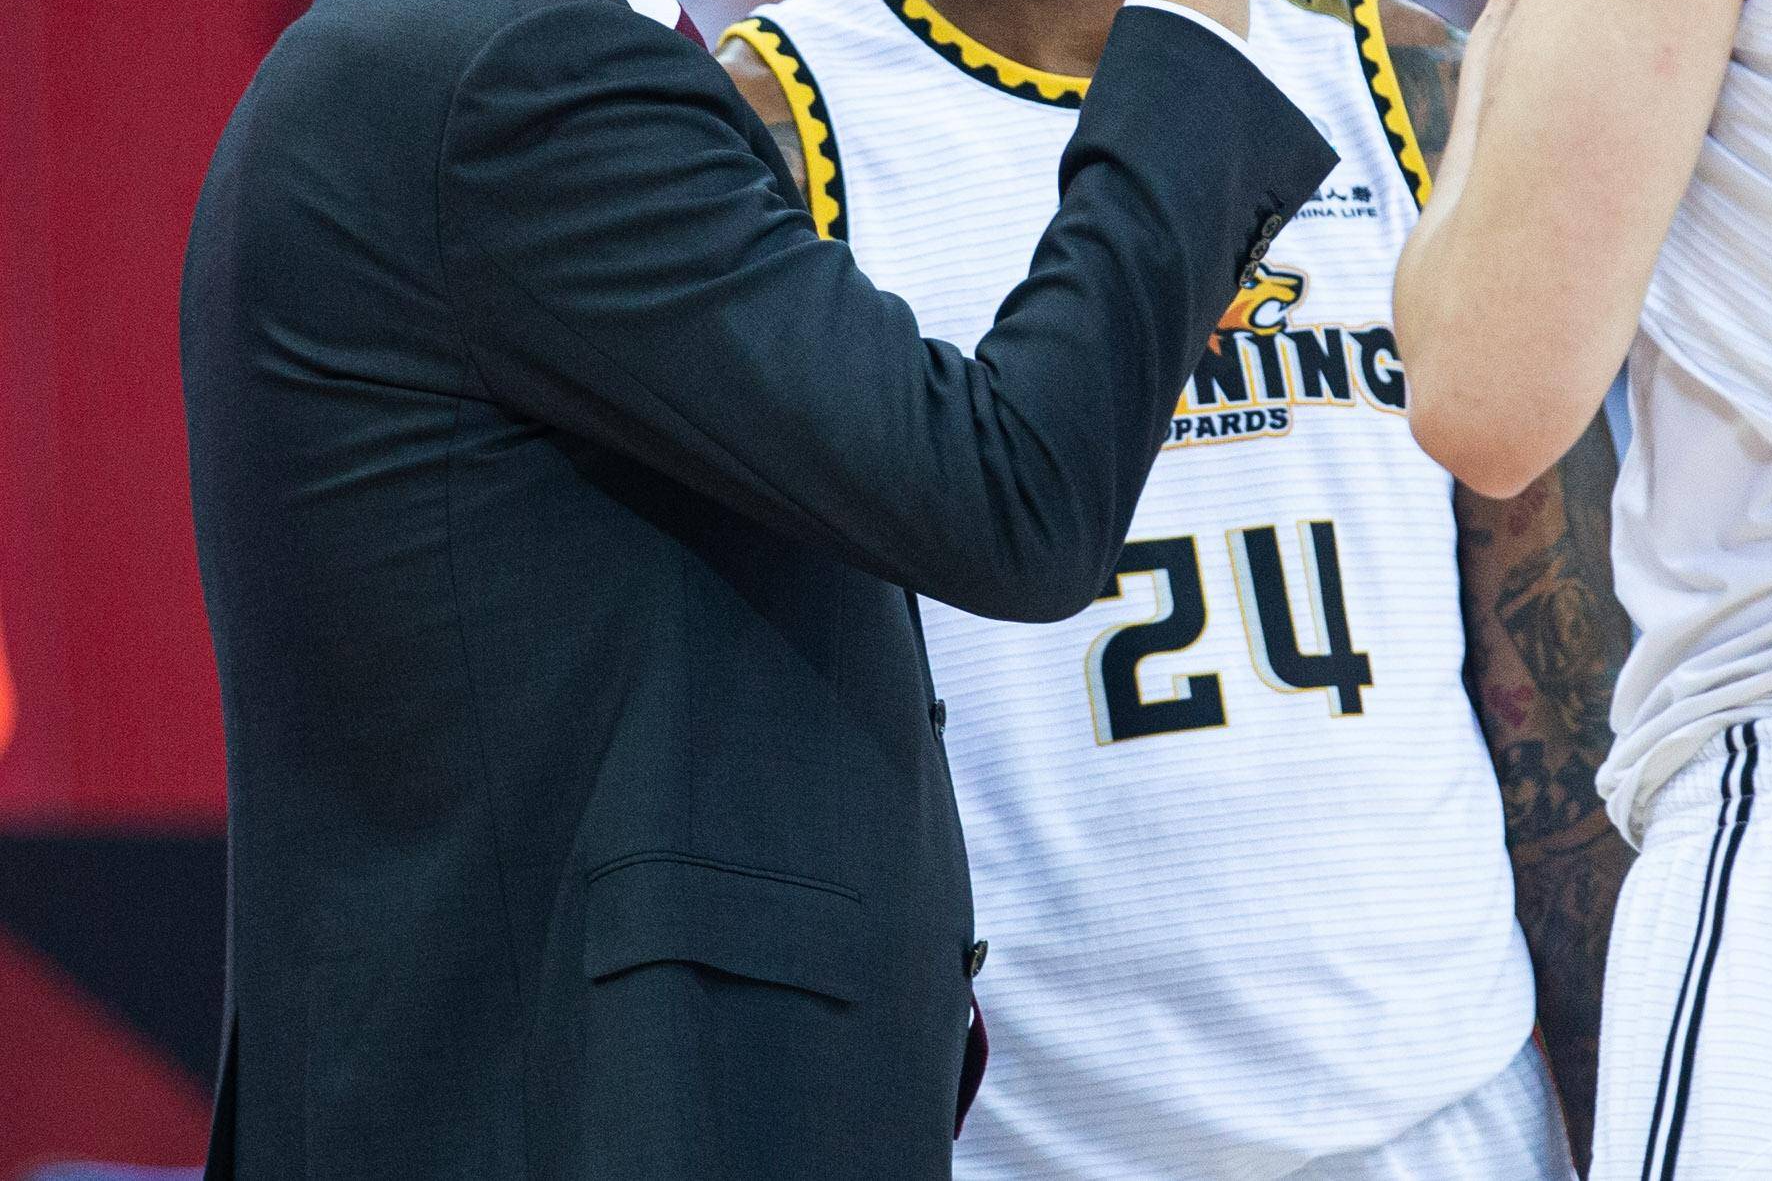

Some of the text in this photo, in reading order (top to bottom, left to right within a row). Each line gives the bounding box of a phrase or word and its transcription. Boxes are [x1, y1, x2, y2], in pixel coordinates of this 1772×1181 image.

[1341, 206, 1377, 218] LIFE
[1190, 326, 1407, 410] NING
[1166, 407, 1288, 441] PARDS
[1084, 520, 1375, 748] 24
